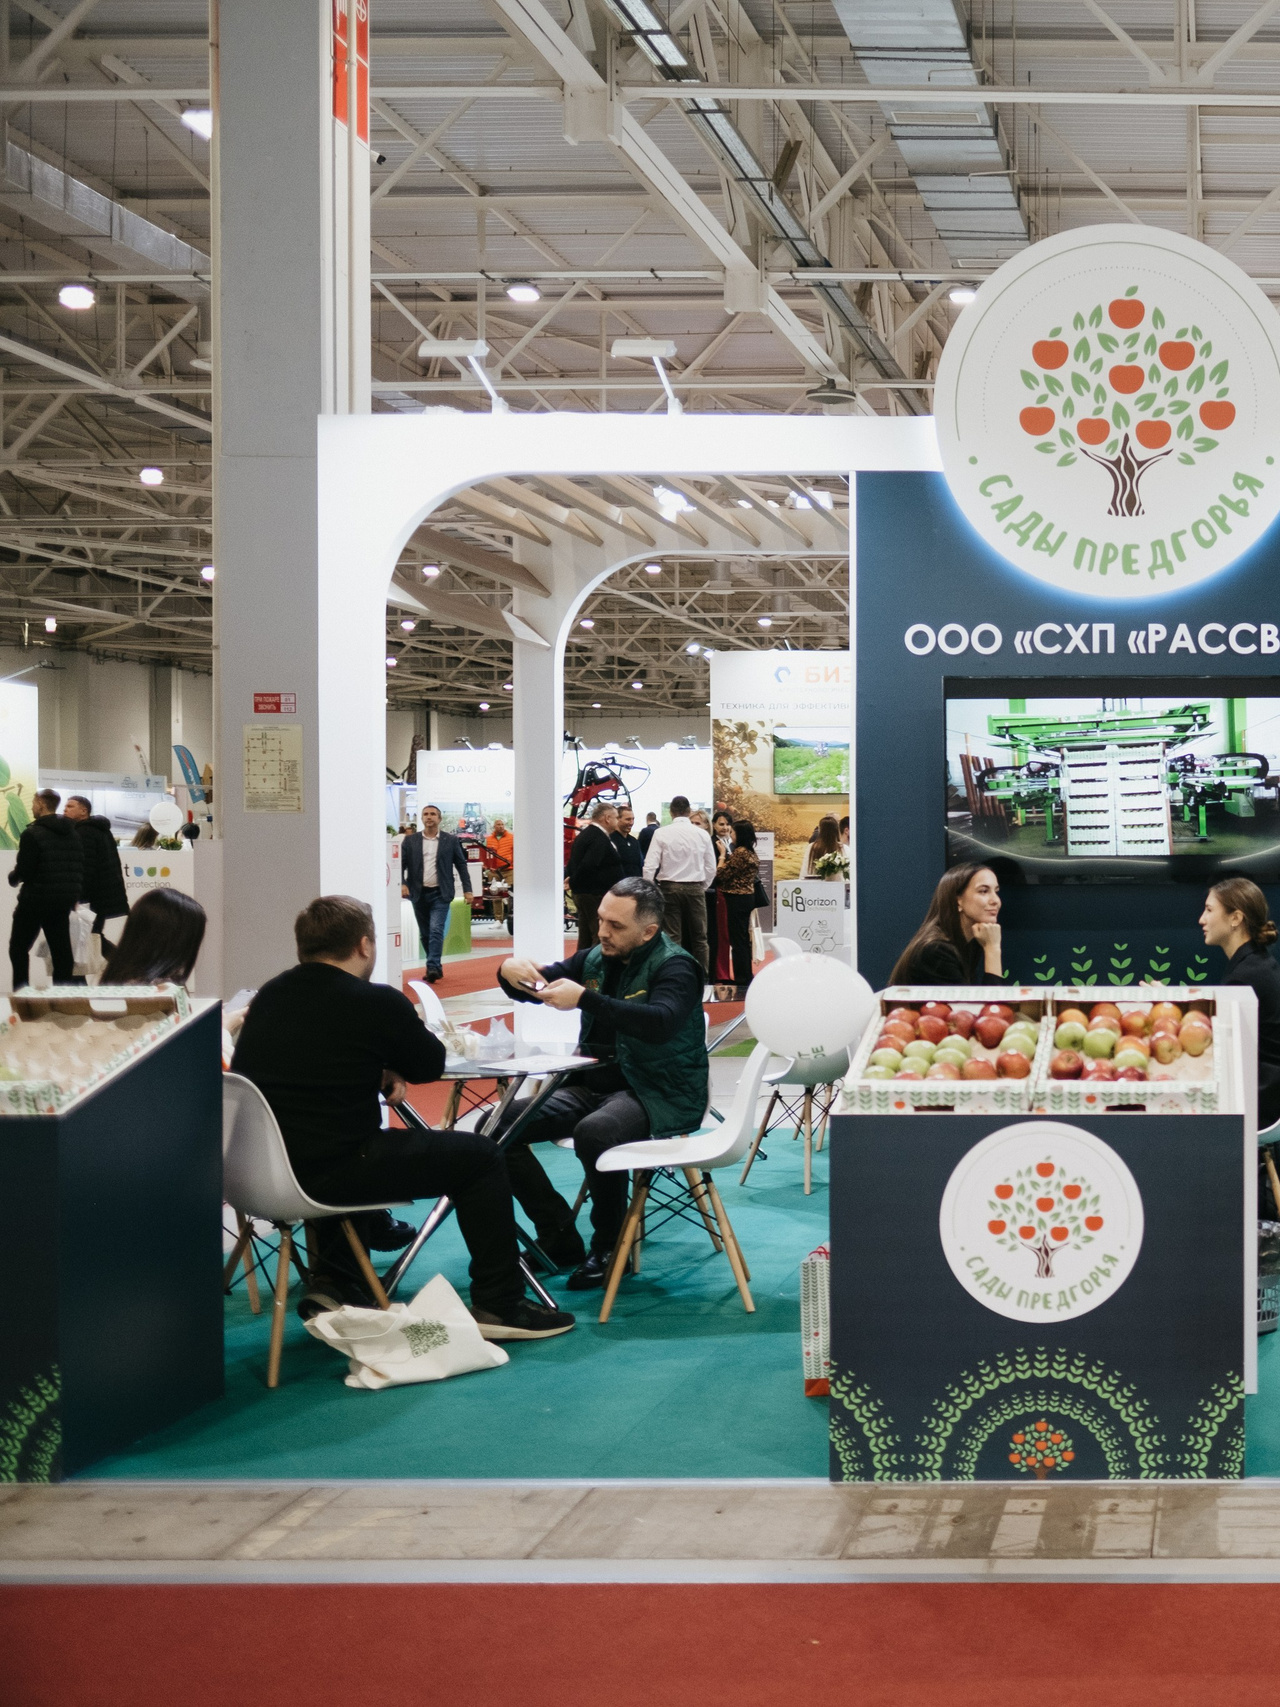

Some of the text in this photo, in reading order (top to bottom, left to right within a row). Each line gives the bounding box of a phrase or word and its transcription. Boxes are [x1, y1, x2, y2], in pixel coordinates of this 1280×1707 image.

[979, 472, 1264, 580] САДЫ ПРЕДГОРЬЯ
[904, 623, 1002, 655] ООО
[1014, 623, 1115, 654] «СХП
[768, 703, 789, 711] ДЛЯ
[447, 765, 487, 773] DAVID
[126, 880, 171, 890] protection
[795, 896, 837, 912] Biorizon
[966, 1254, 1119, 1311] САДЫ ПРЕДГОРЬЯ
